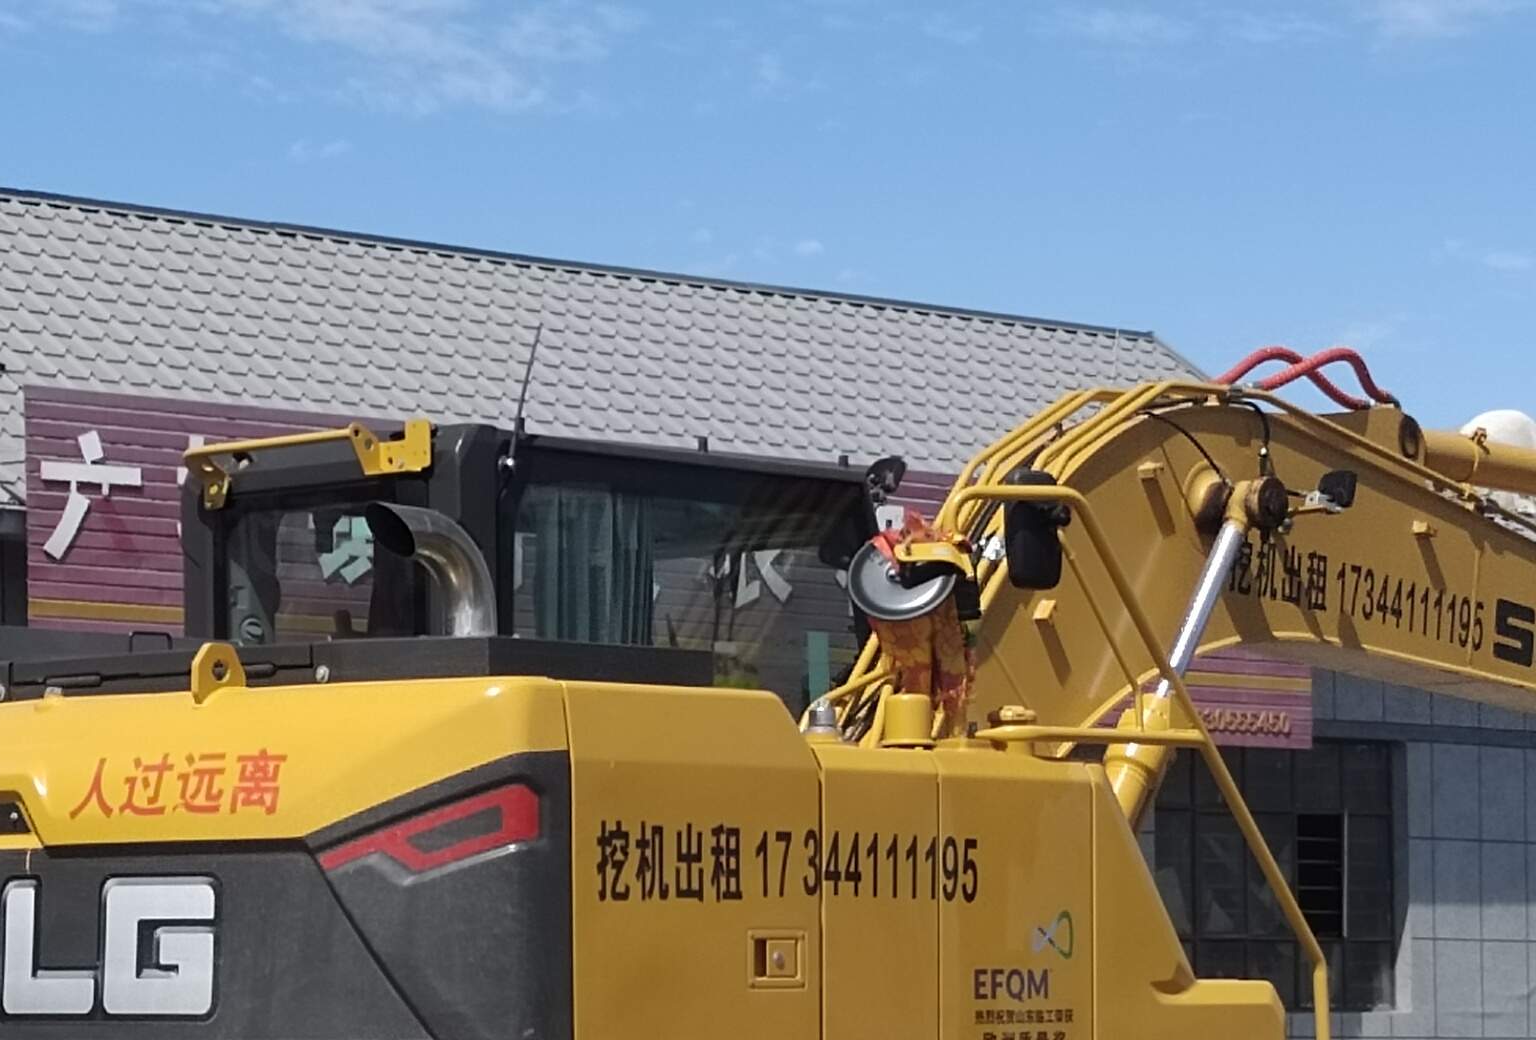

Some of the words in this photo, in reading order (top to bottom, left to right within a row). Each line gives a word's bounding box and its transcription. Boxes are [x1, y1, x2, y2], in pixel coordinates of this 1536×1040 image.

[1336, 562, 1485, 651] 17344111195
[69, 748, 288, 821] 人过远离
[596, 820, 743, 904] 挖机出租
[974, 968, 1049, 1002] EFQM
